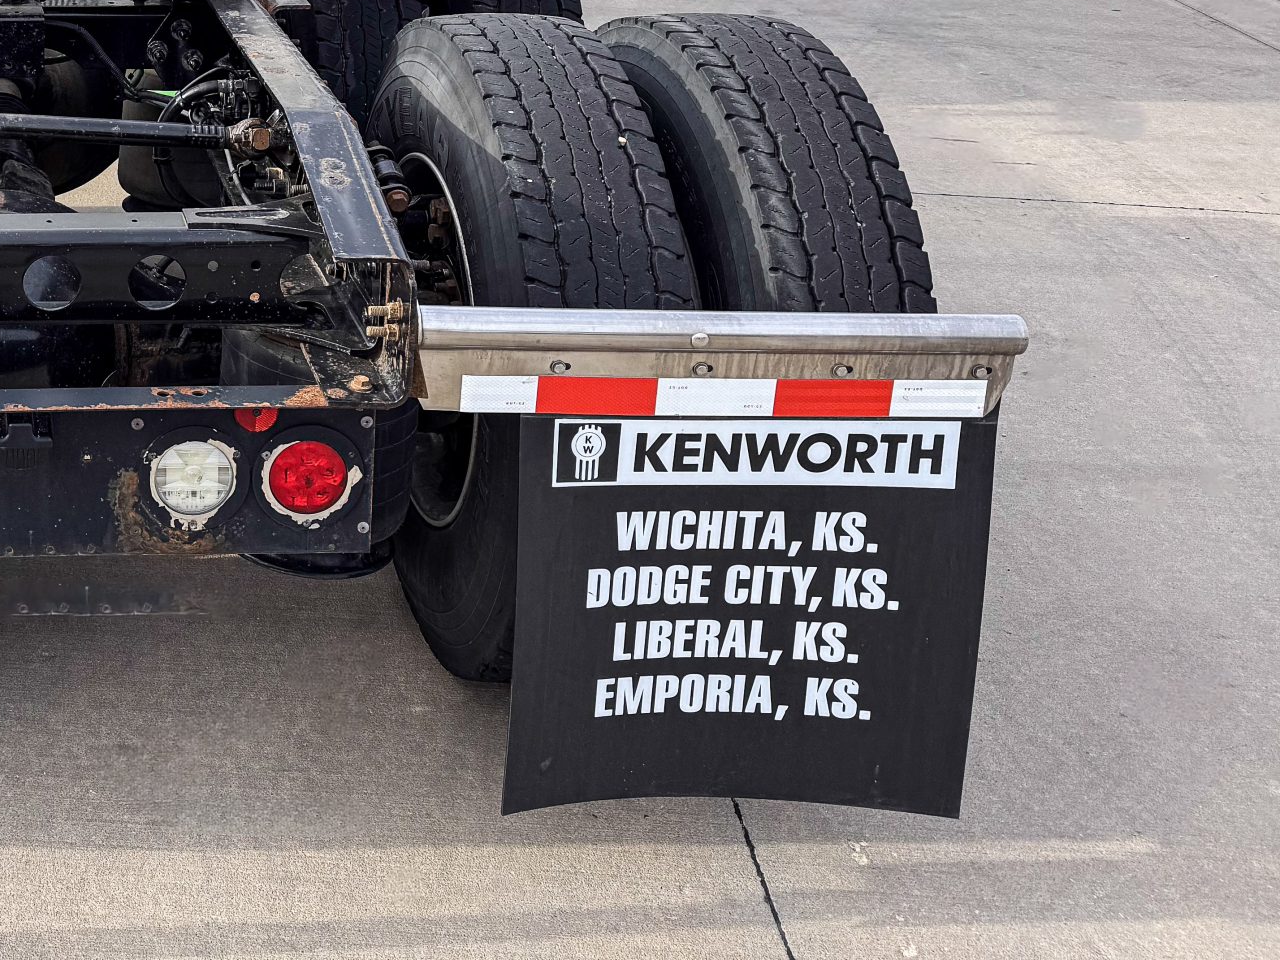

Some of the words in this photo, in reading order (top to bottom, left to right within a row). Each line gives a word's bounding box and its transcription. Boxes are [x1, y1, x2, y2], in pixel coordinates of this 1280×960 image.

[583, 445, 594, 454] W
[585, 435, 592, 444] K
[634, 433, 944, 474] KENWORTH
[617, 510, 803, 557] WICHITA,
[812, 511, 878, 554] KS.
[586, 565, 712, 609] DODGE
[725, 565, 823, 613] CITY,
[832, 568, 900, 611] KS.
[613, 619, 783, 666] LIBERAL,
[793, 621, 859, 664] KS.
[594, 674, 789, 721] EMPORIA,
[804, 677, 871, 721] KS.
